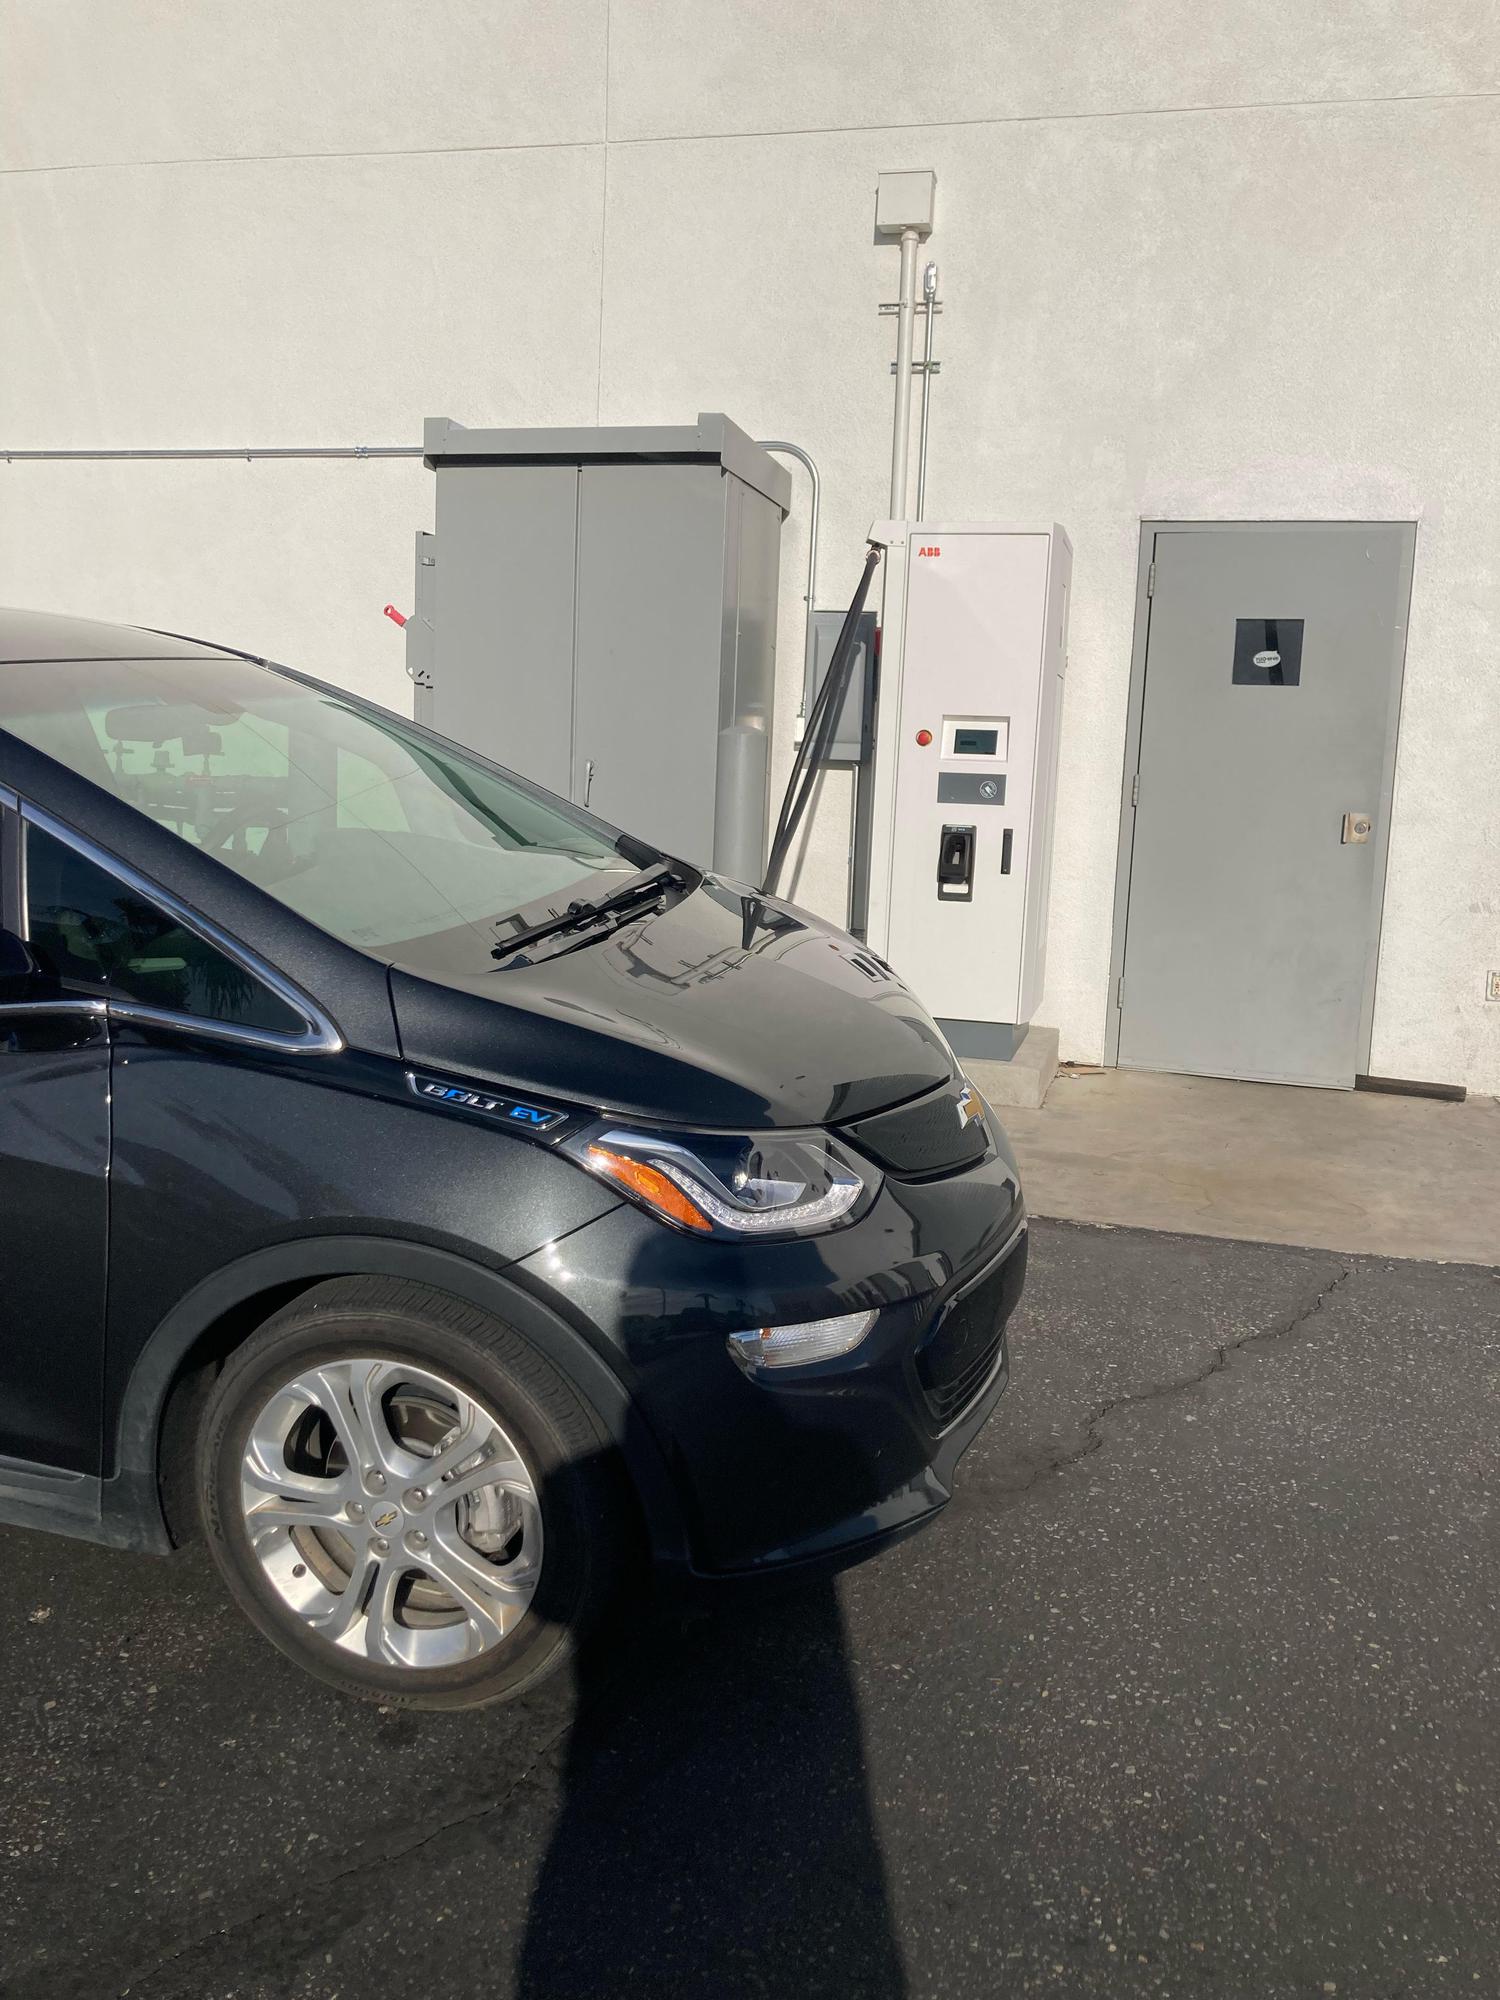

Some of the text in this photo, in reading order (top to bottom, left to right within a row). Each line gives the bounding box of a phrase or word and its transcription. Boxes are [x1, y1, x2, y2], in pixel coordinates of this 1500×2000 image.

[918, 547, 941, 557] ABB
[423, 1083, 552, 1123] BOLT EV
